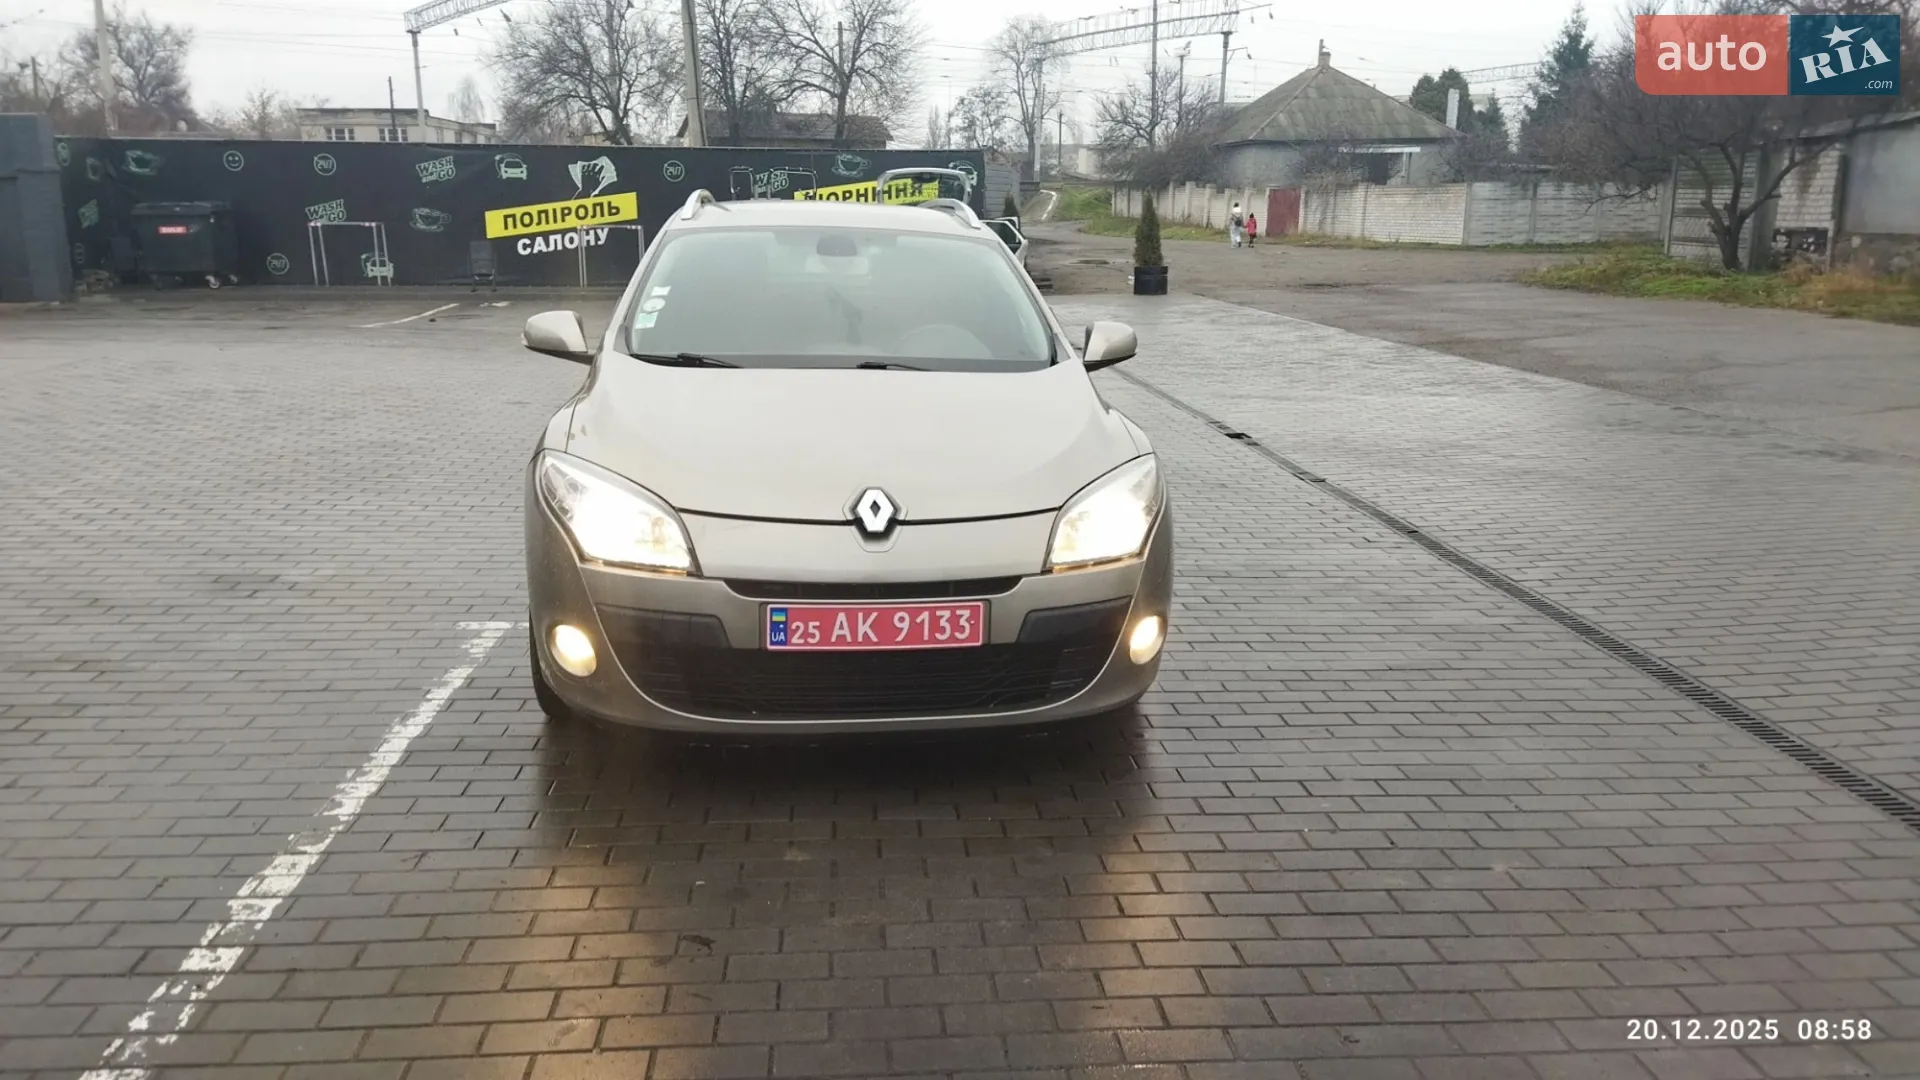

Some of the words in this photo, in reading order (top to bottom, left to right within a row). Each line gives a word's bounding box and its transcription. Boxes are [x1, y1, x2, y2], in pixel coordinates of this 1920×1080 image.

[416, 156, 453, 176] WASH
[437, 166, 456, 181] GO
[813, 182, 923, 201] ОРНІННЯ
[305, 199, 344, 219] WASH
[328, 209, 347, 223] GO
[503, 202, 621, 230] ПОЛІРОЛЬ
[517, 228, 610, 255] САЛОНУ
[771, 632, 786, 642] UA
[791, 621, 820, 644] 25
[831, 611, 879, 642] AK
[893, 610, 971, 642] 9133
